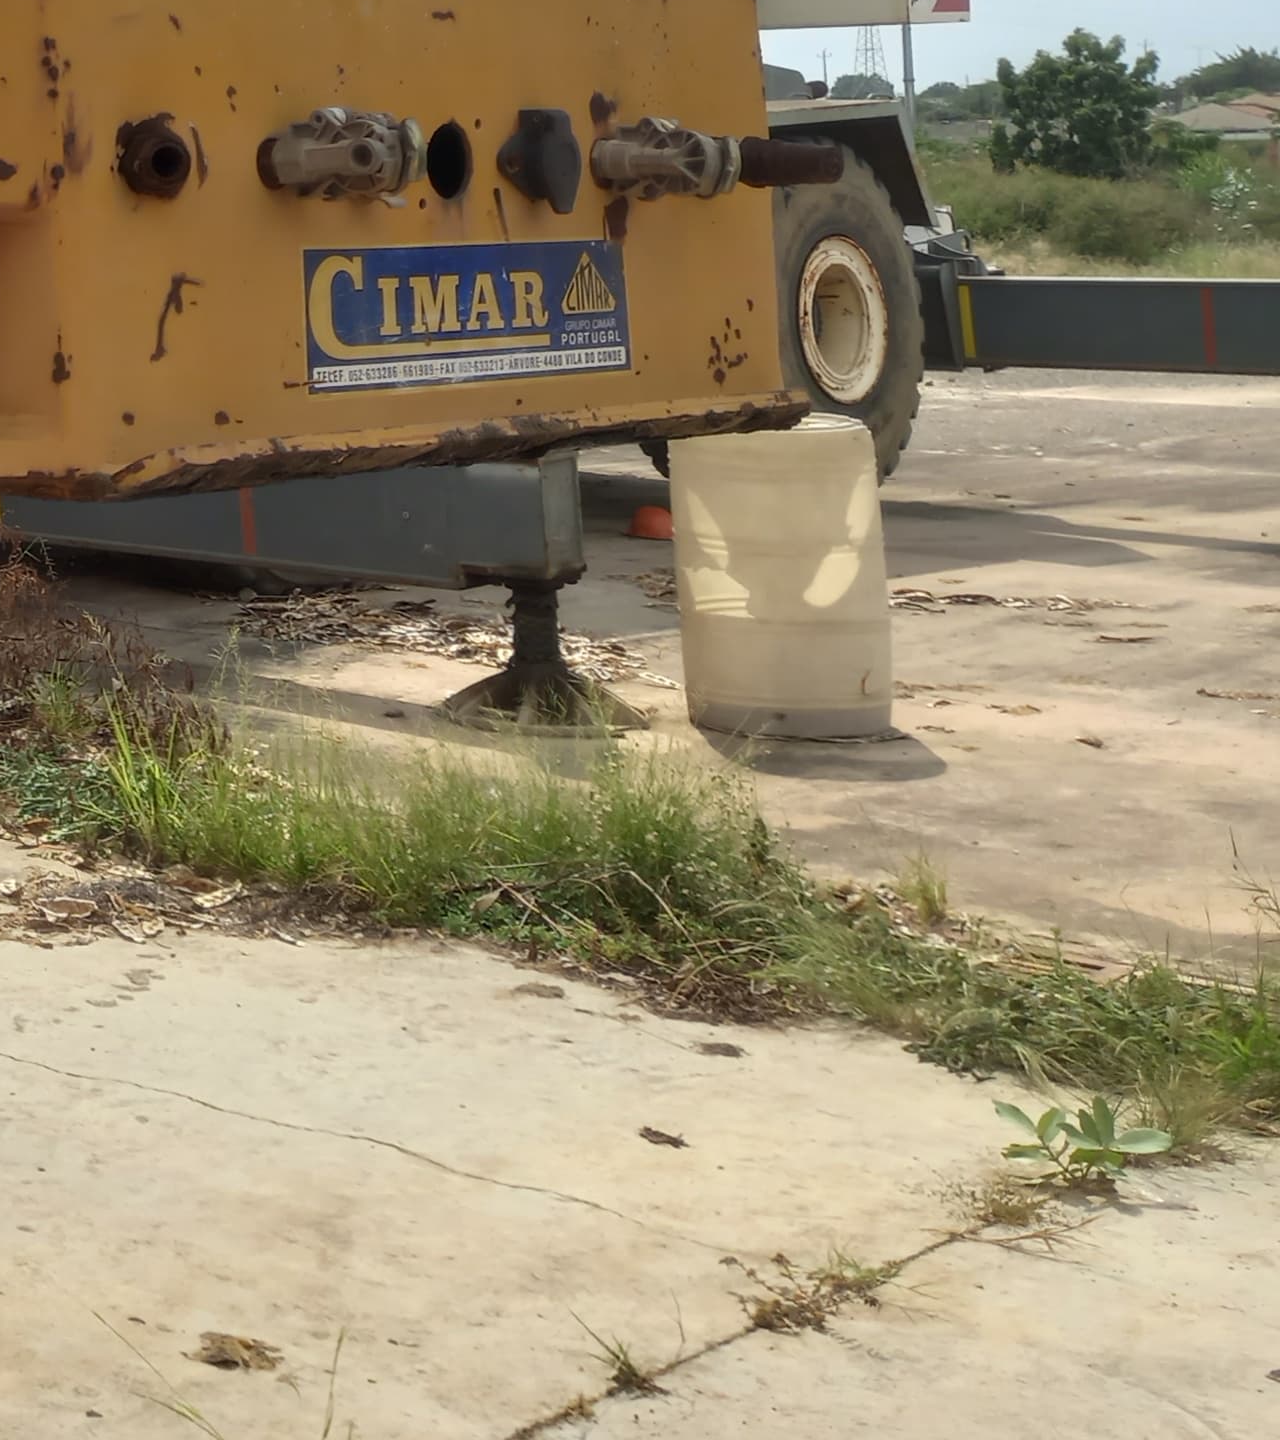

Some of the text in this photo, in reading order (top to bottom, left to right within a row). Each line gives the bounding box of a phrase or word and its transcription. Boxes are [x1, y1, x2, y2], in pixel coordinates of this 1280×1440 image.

[566, 261, 612, 311] CIMAR
[309, 254, 552, 361] CIMAR
[565, 318, 616, 331] GRUPO CIMAR
[560, 330, 622, 346] PORTUGAL
[566, 352, 582, 366] VILA
[585, 351, 596, 364] DO
[598, 348, 623, 363] CONDE
